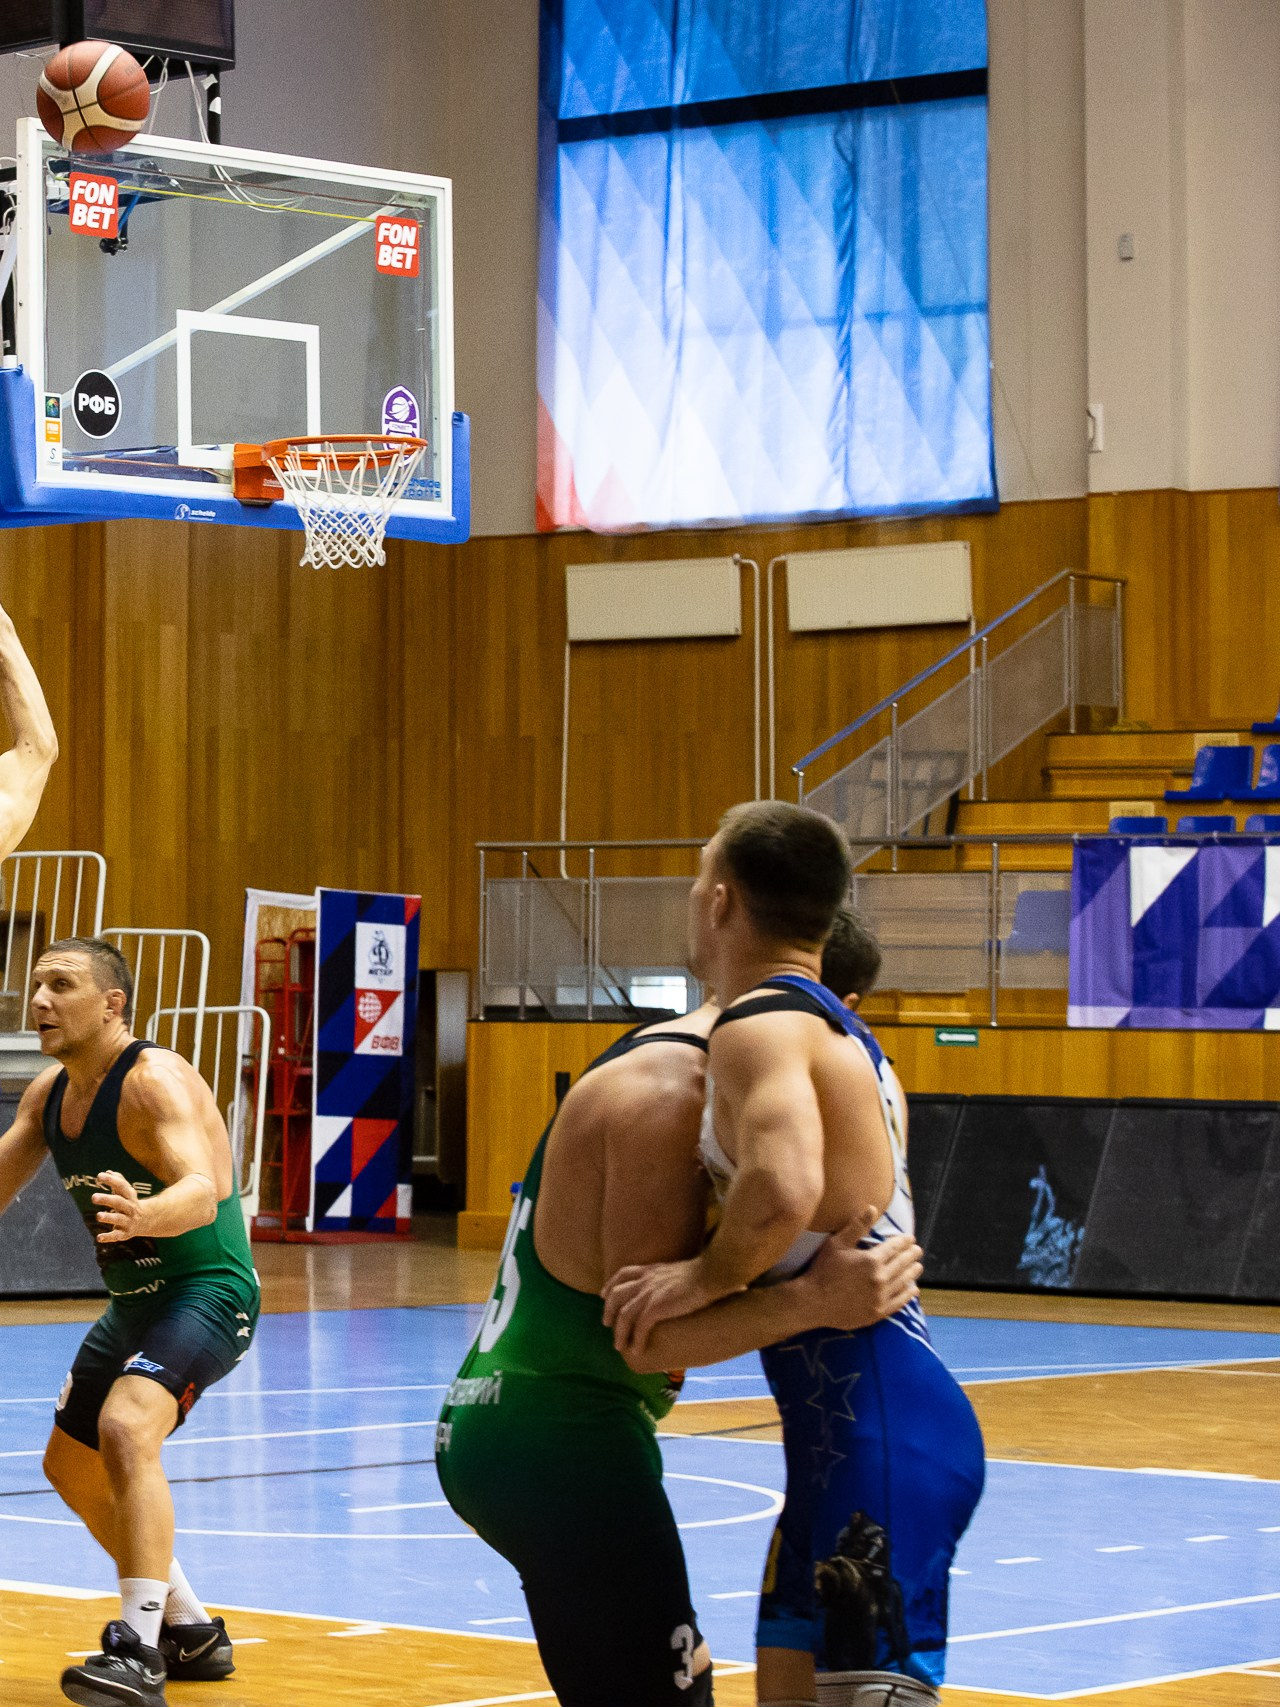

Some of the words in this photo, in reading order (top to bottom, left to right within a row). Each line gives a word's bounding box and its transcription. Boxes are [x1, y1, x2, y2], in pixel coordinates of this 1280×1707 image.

[71, 180, 116, 206] FON
[71, 203, 116, 230] BET
[377, 222, 417, 247] FON
[377, 244, 417, 270] BET
[78, 393, 116, 415] РФБ
